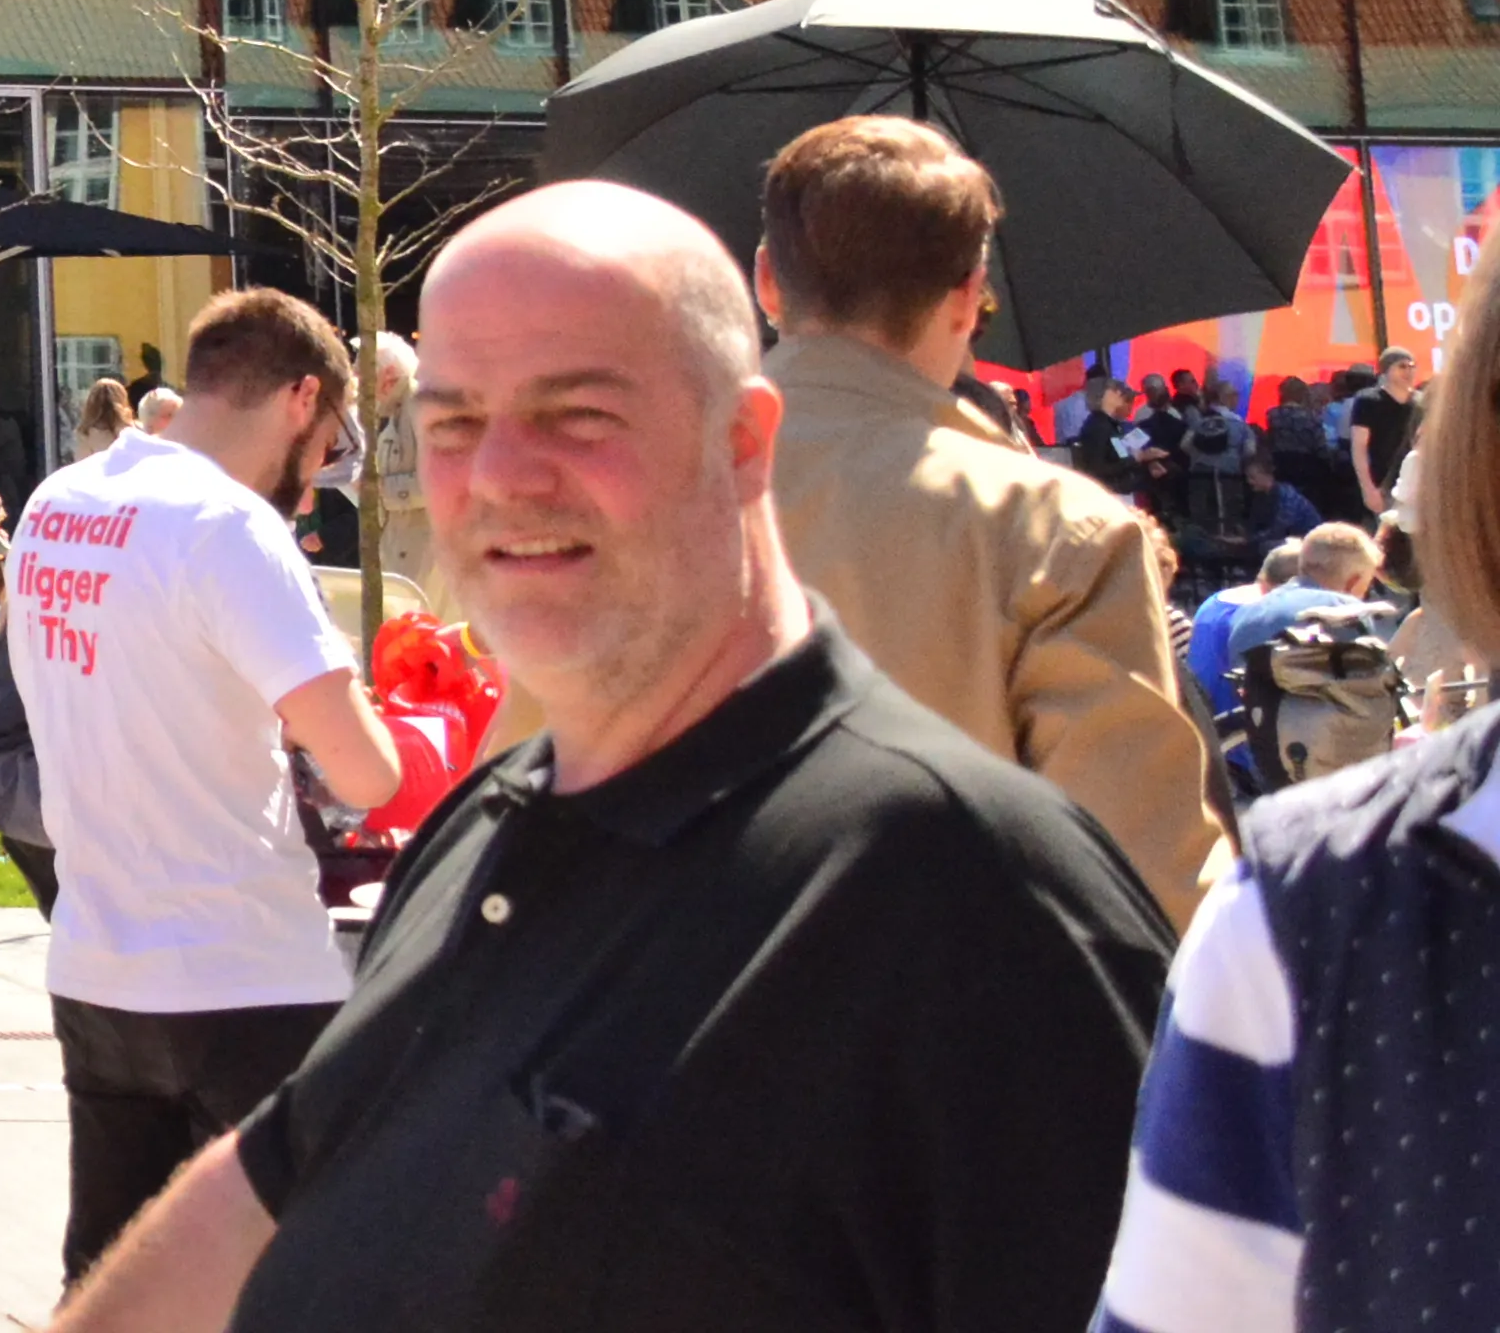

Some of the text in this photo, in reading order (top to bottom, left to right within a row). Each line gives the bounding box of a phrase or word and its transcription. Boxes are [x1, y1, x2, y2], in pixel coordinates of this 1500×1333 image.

[24, 500, 139, 549] Hawaii
[17, 551, 111, 613] ligger
[39, 615, 98, 676] Thy
